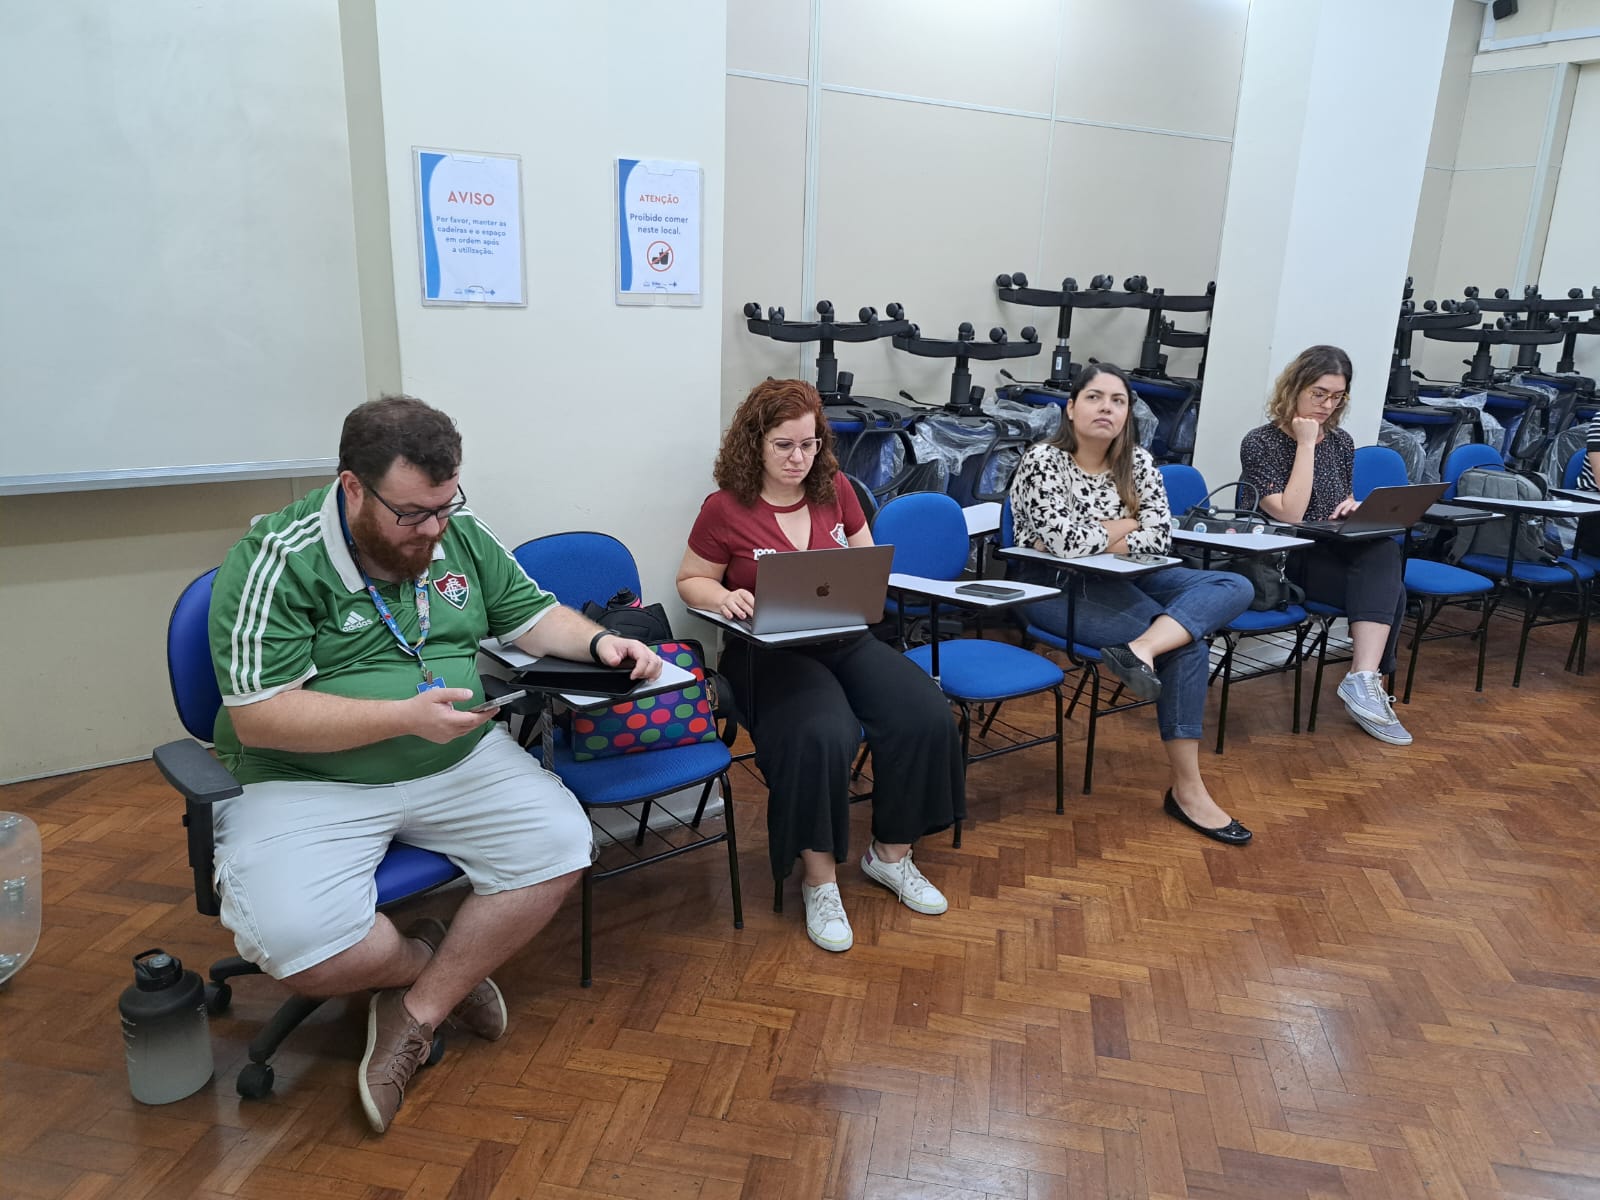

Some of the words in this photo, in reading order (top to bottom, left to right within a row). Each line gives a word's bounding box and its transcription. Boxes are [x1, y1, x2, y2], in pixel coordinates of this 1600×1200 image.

[447, 190, 495, 207] AVISO
[639, 193, 680, 205] ATENÇÃO
[450, 216, 471, 225] favor,
[630, 213, 663, 222] Proibido
[664, 216, 688, 224] comer
[437, 226, 467, 234] cadeiras
[637, 226, 659, 234] neste
[661, 226, 681, 235] local.
[483, 238, 500, 246] após
[342, 618, 374, 632] adidas
